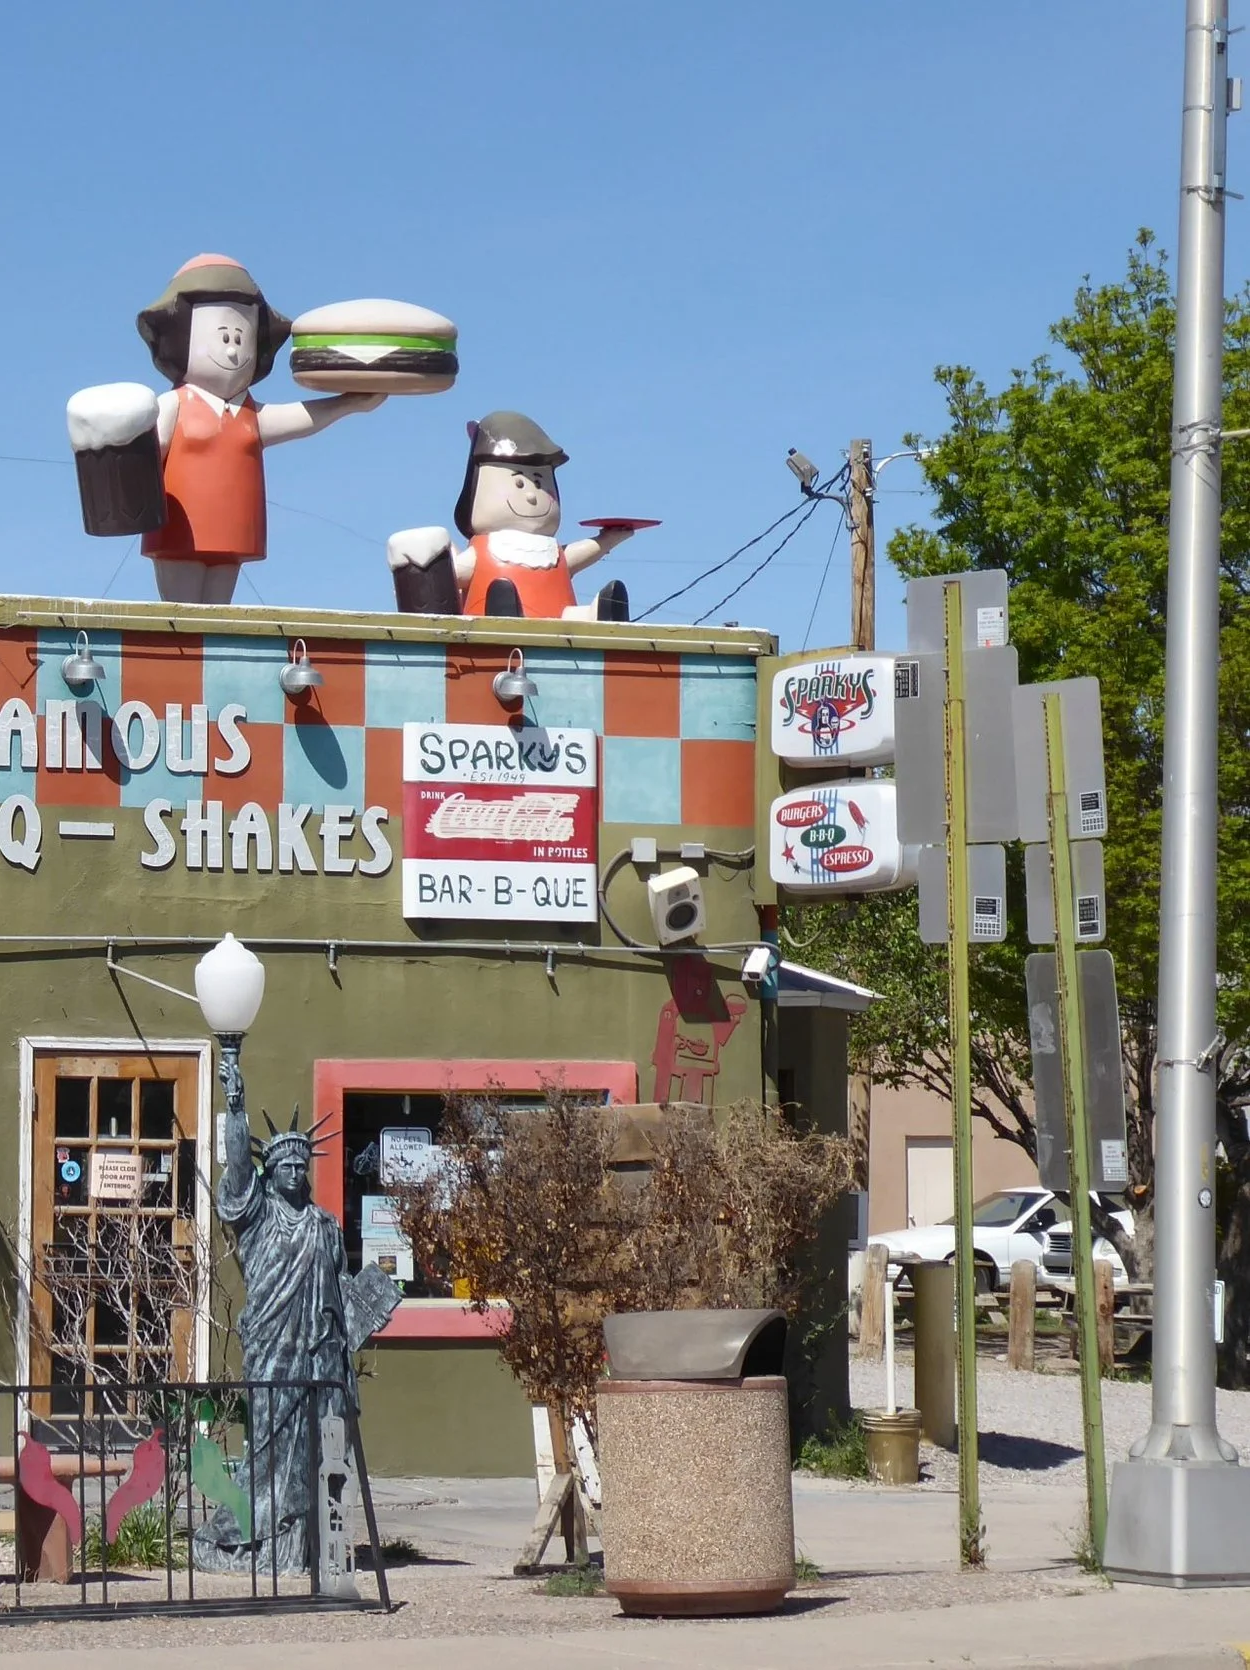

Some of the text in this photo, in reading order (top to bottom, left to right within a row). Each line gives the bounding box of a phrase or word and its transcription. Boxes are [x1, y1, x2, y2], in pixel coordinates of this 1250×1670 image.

[419, 732, 587, 775] SPARKY'S
[498, 772, 526, 783] 1949
[421, 790, 446, 799] DRINK
[781, 804, 824, 822] BURGERS
[141, 798, 393, 875] SHAKES
[810, 827, 835, 843] B-B-Q
[533, 846, 588, 858] IN BOTTLES
[824, 849, 870, 866] ESPRESSO
